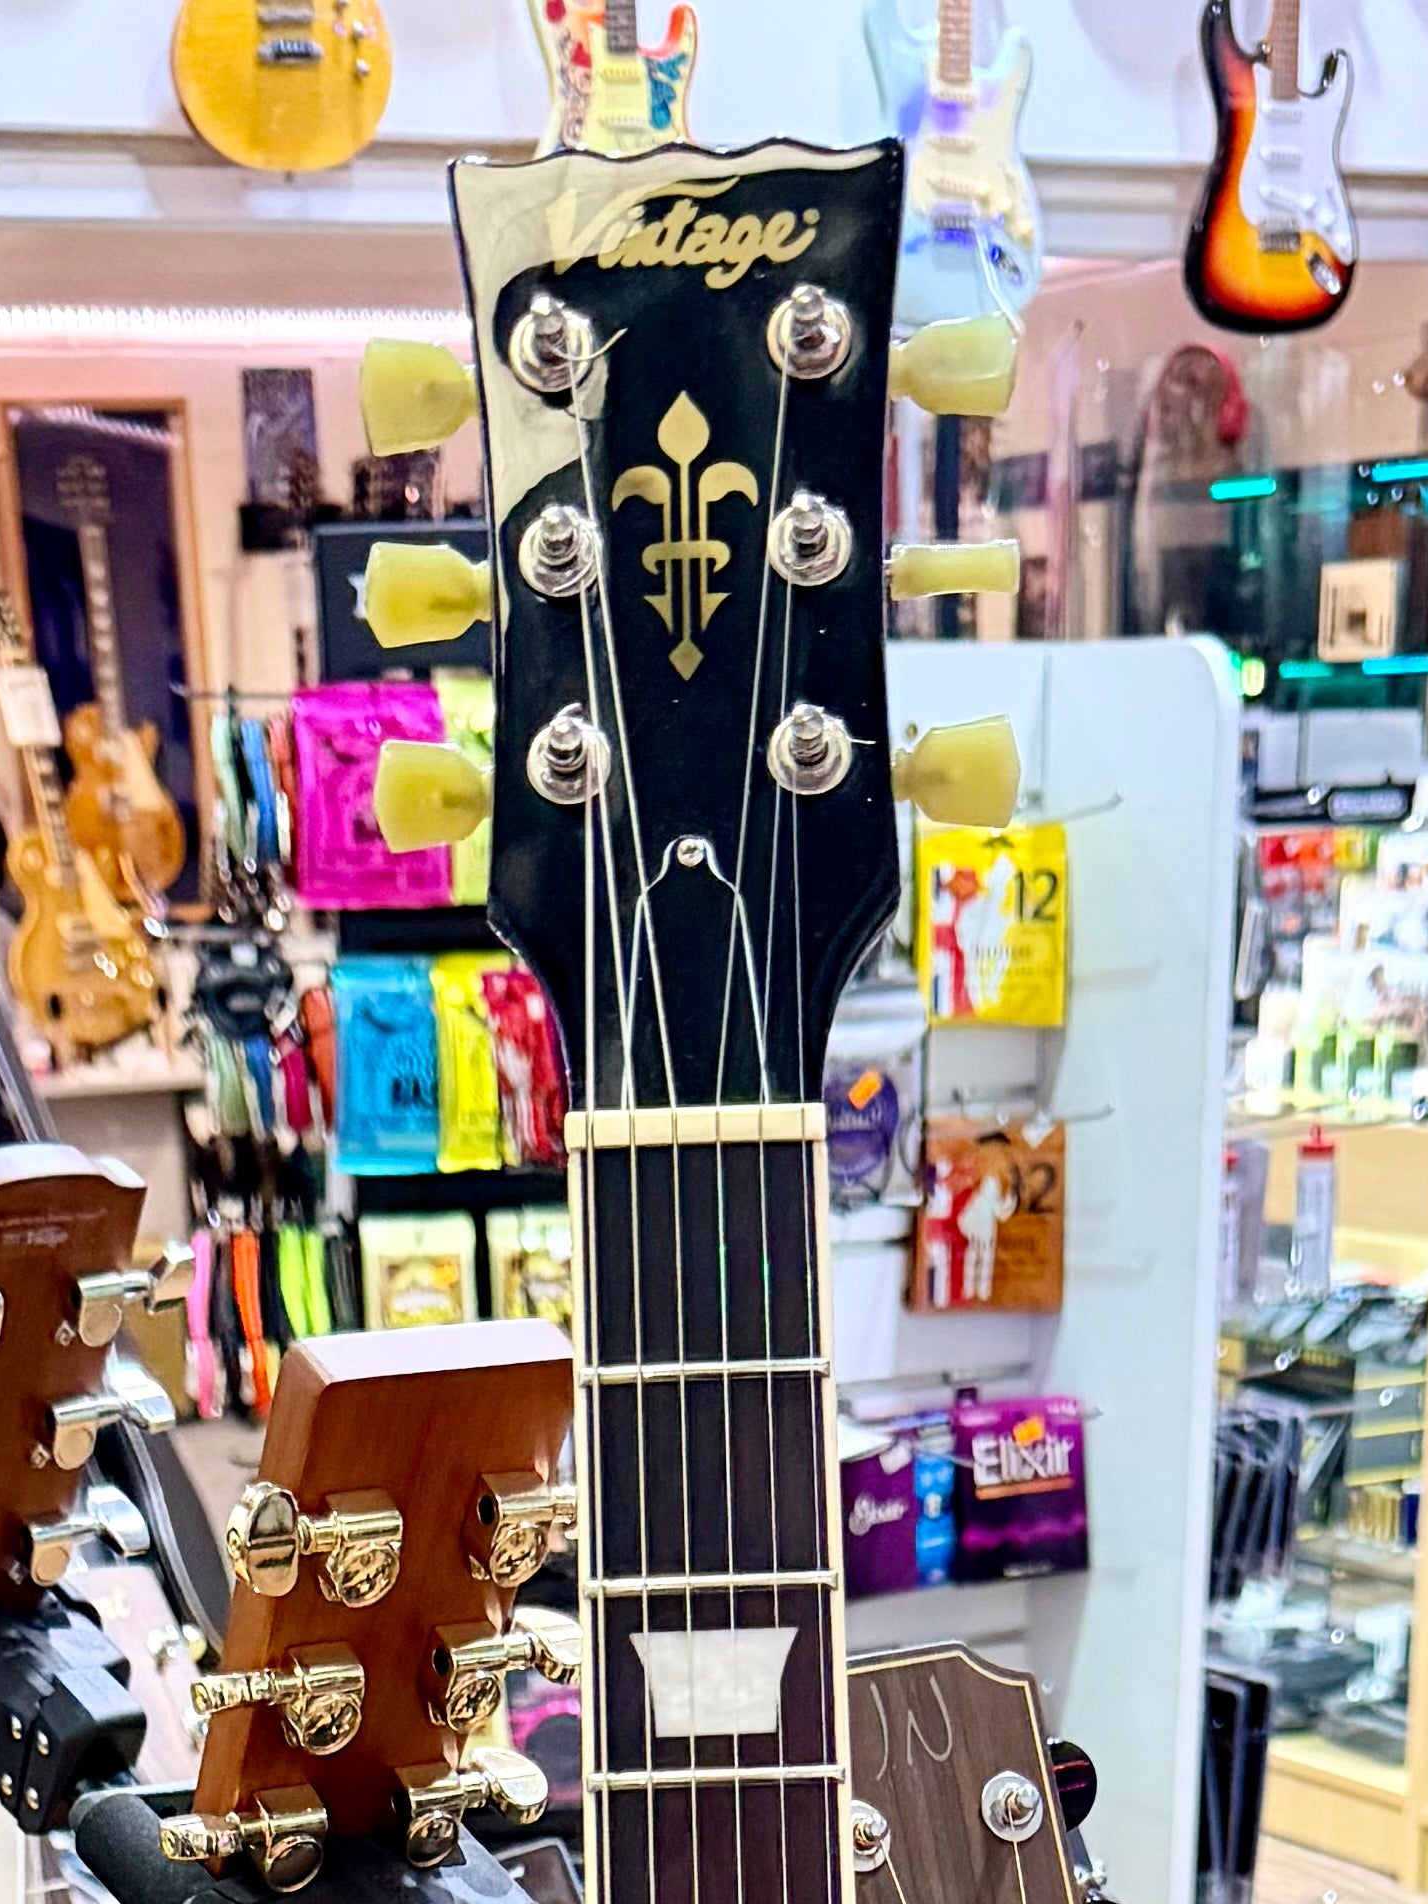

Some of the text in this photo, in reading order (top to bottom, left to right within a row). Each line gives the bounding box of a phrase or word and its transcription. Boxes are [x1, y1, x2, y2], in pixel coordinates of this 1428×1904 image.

[546, 175, 821, 290] Vintage
[1015, 866, 1059, 923] 12
[972, 1431, 1075, 1488] Elixir
